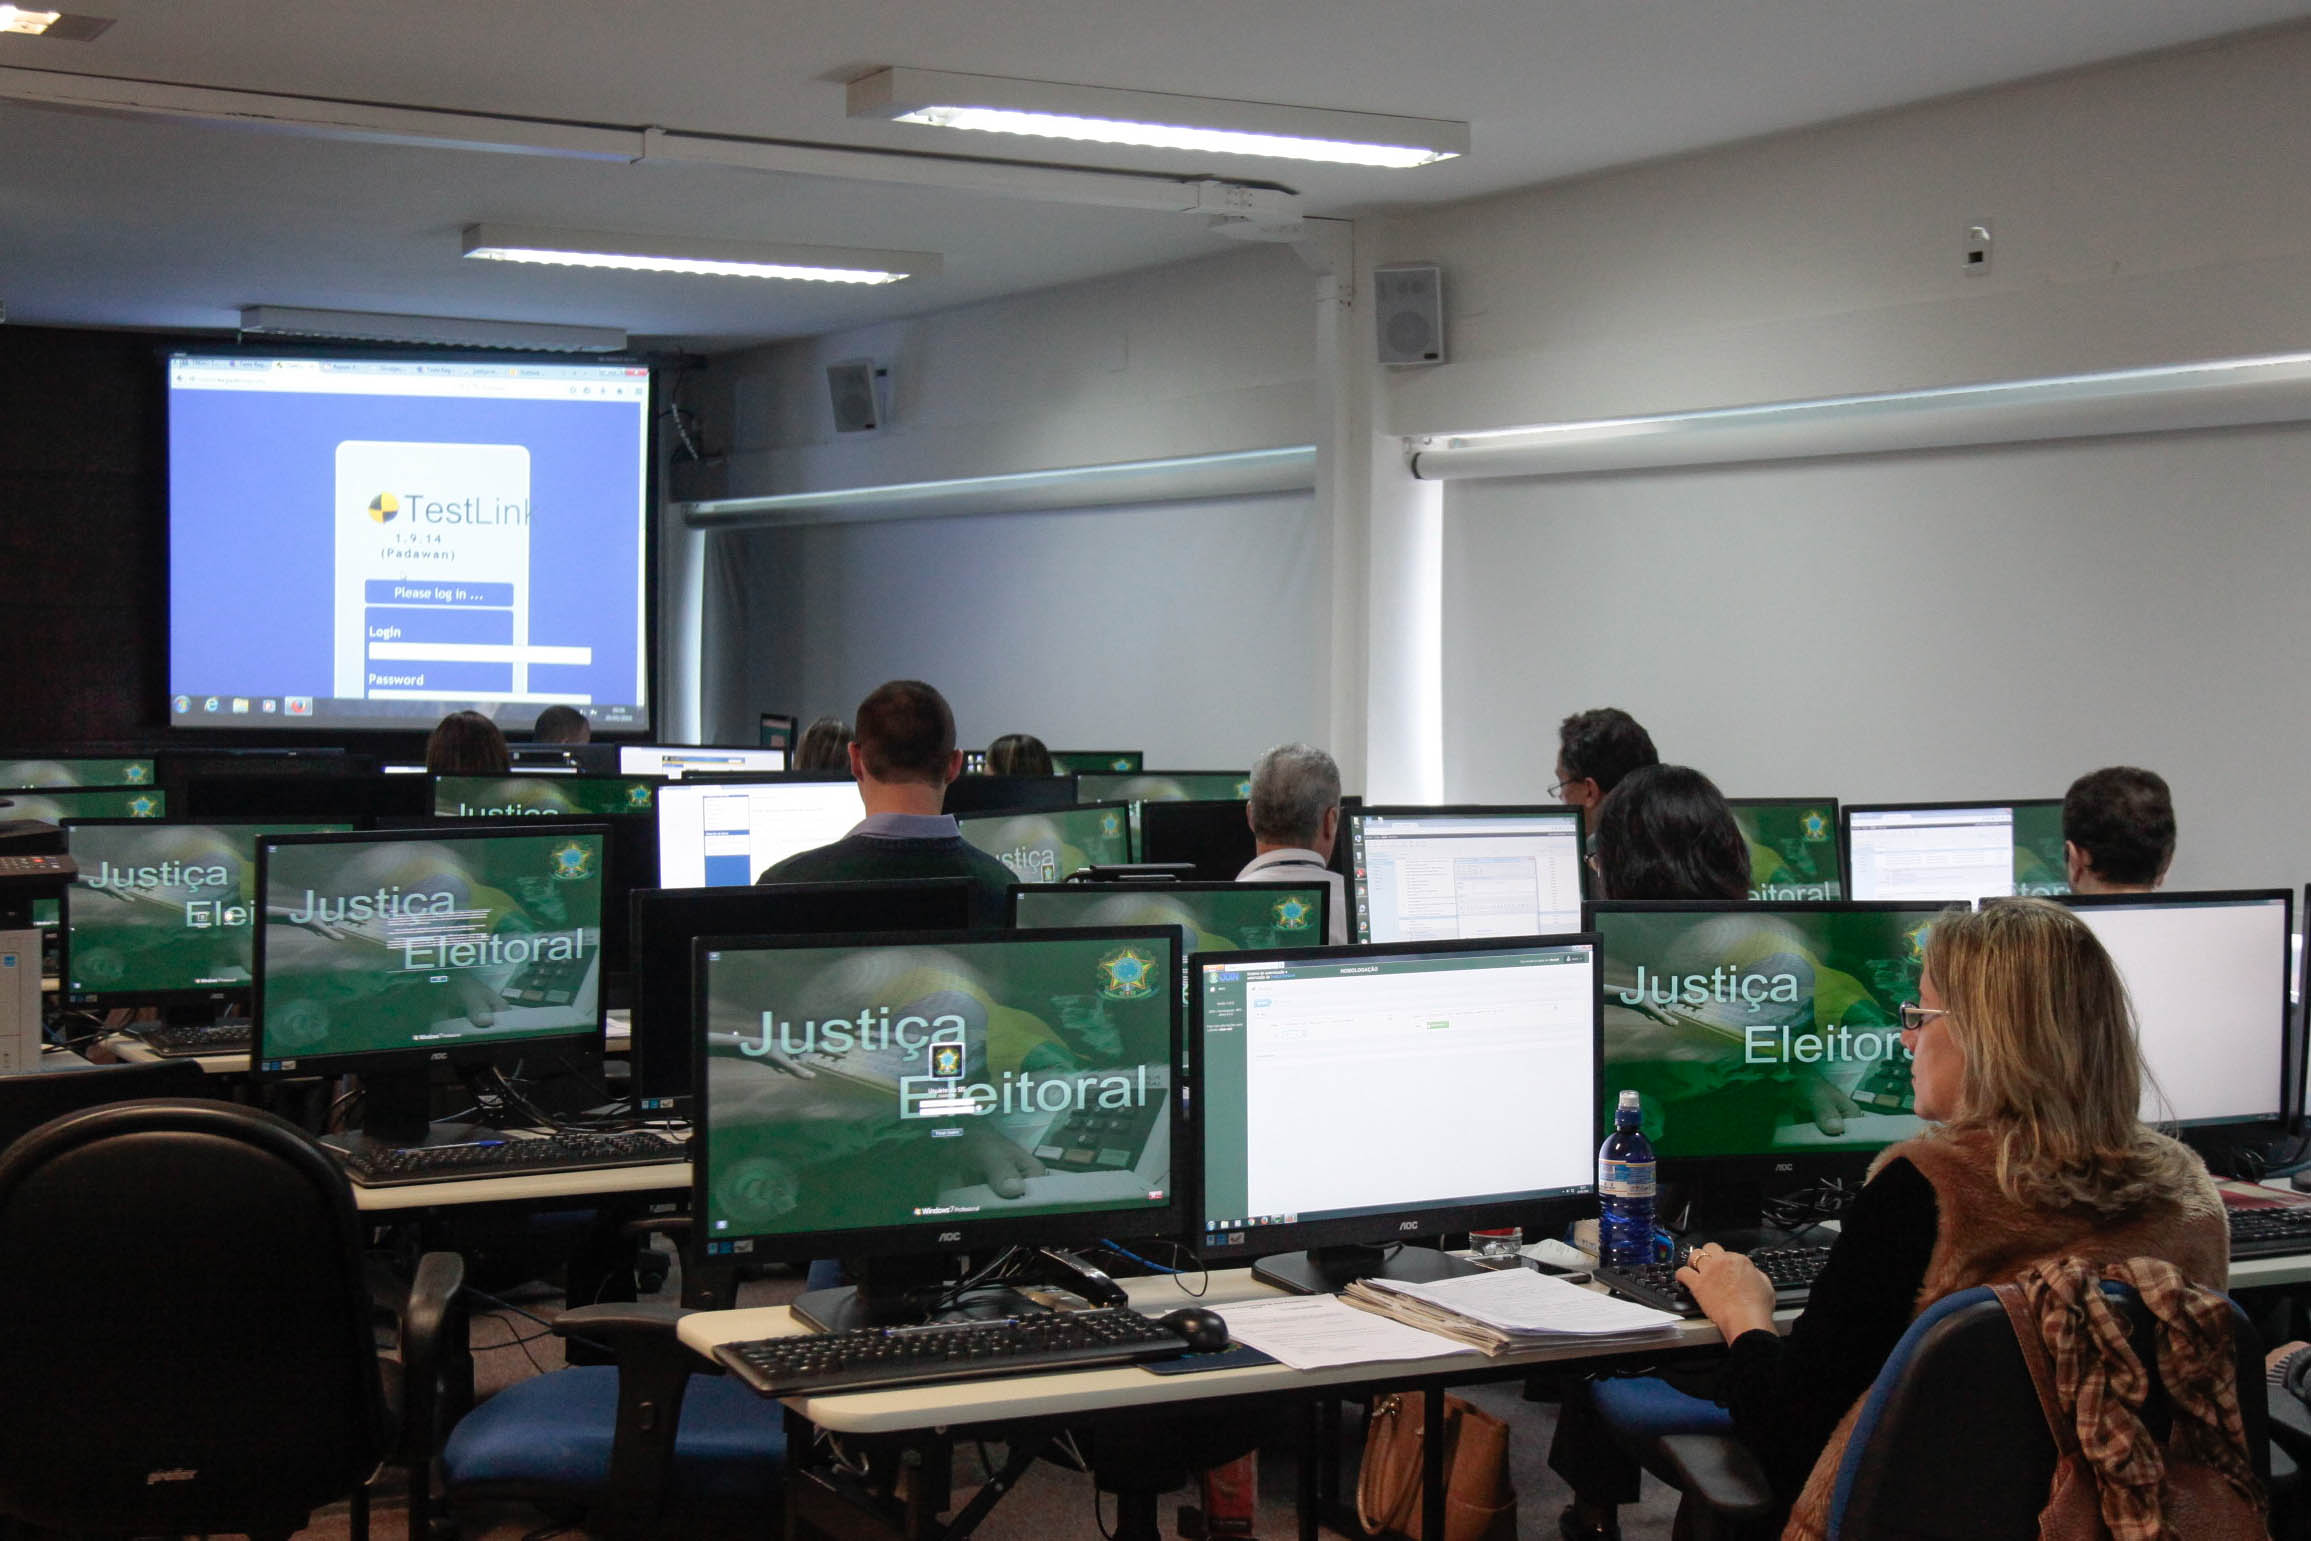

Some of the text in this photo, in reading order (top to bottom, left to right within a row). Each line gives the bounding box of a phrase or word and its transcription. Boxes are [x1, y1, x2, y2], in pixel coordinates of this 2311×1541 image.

[404, 494, 537, 526] TestLink
[395, 533, 442, 543] 1.9.14
[381, 549, 455, 560] (Padawan)
[394, 586, 432, 599] Please
[434, 588, 454, 602] log
[455, 588, 467, 600] in
[369, 626, 401, 639] Login
[368, 673, 425, 686] Password
[88, 860, 229, 893] Justiça
[1620, 964, 1799, 1013] Justiça
[739, 1006, 967, 1062] Justiça
[1399, 1221, 1418, 1231] AOC
[938, 1232, 961, 1242] AOC
